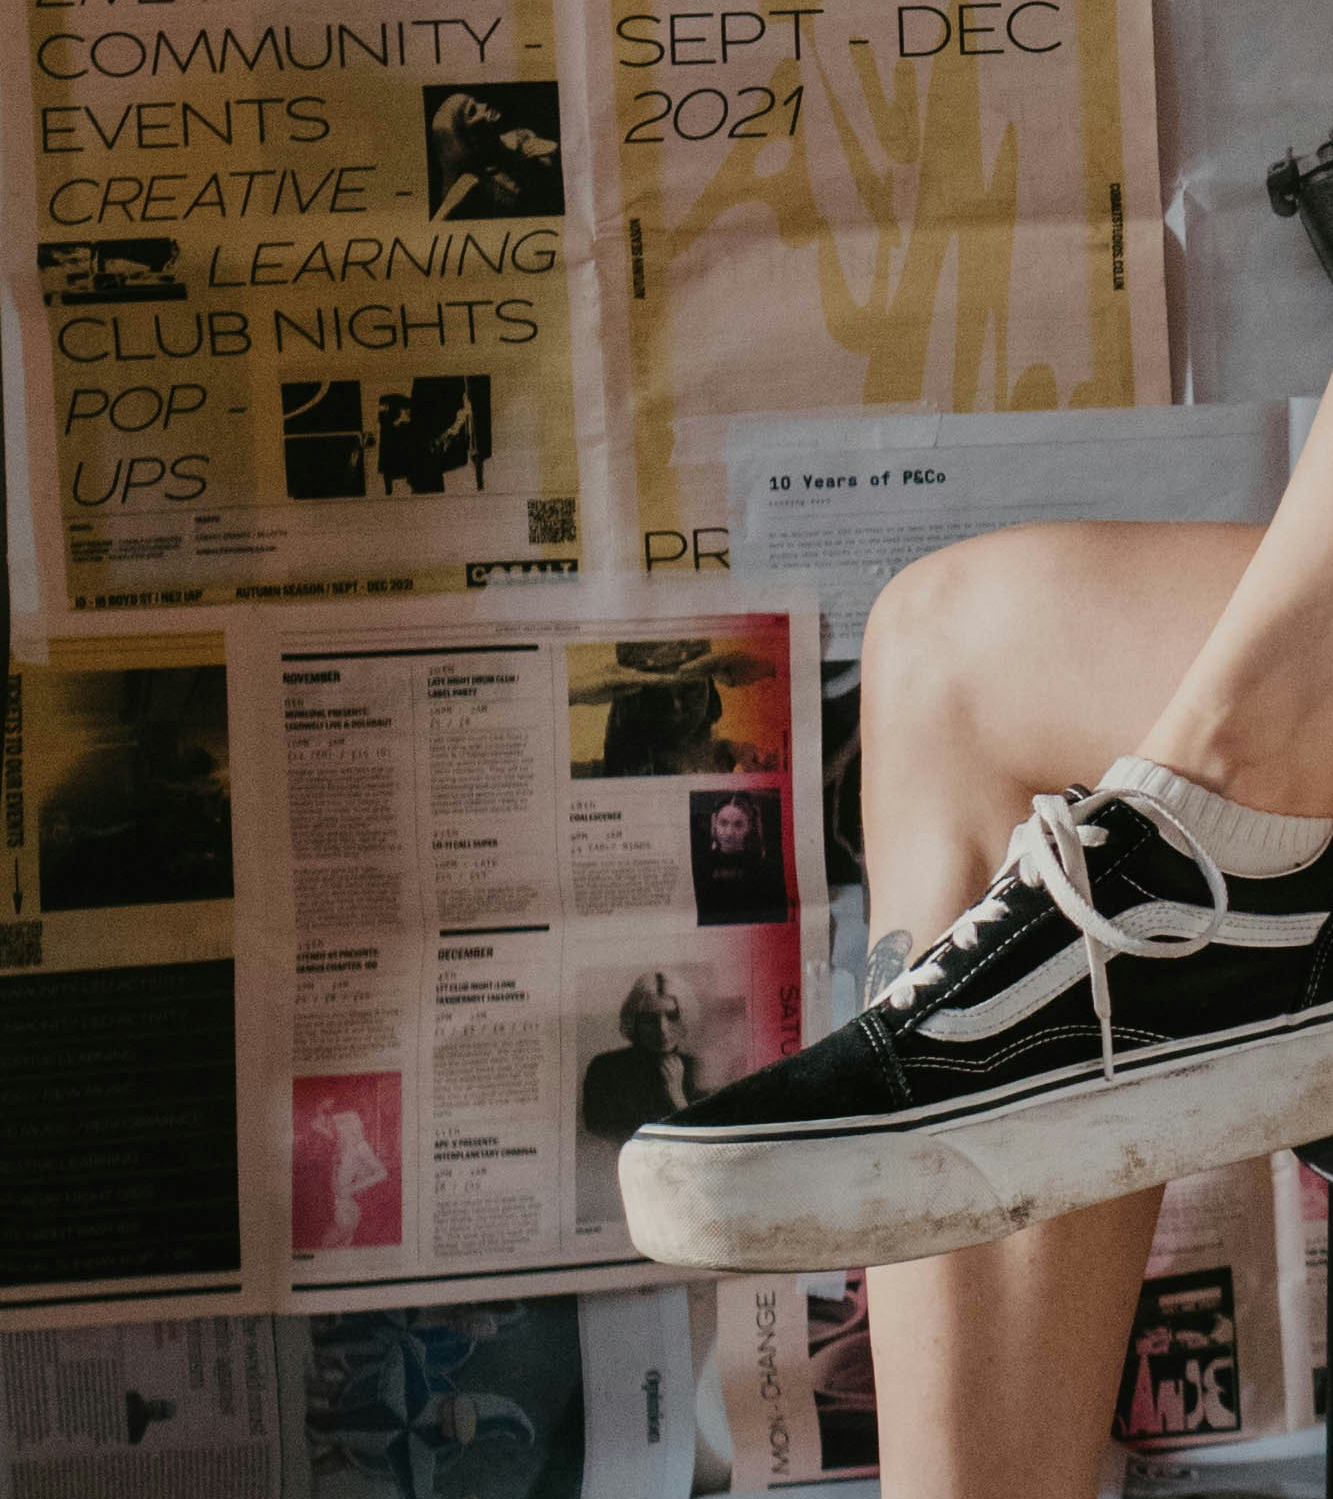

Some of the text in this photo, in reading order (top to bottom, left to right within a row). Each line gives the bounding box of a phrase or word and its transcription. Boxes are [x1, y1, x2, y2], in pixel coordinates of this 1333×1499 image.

[36, 16, 505, 82] COMMUNITY
[614, 0, 1065, 69] SEPT DEC
[41, 96, 331, 154] EVENTS
[622, 83, 808, 146] 2021
[47, 164, 378, 227] CREATIVE
[207, 228, 559, 289] LEARNING
[57, 298, 540, 363] CLUB NIGHTS
[65, 382, 207, 437] POP
[71, 453, 212, 507] UPS
[768, 468, 948, 491] 10 Years of P&Co
[282, 669, 342, 687] NOVEMBER
[436, 944, 495, 963] DECEMBER
